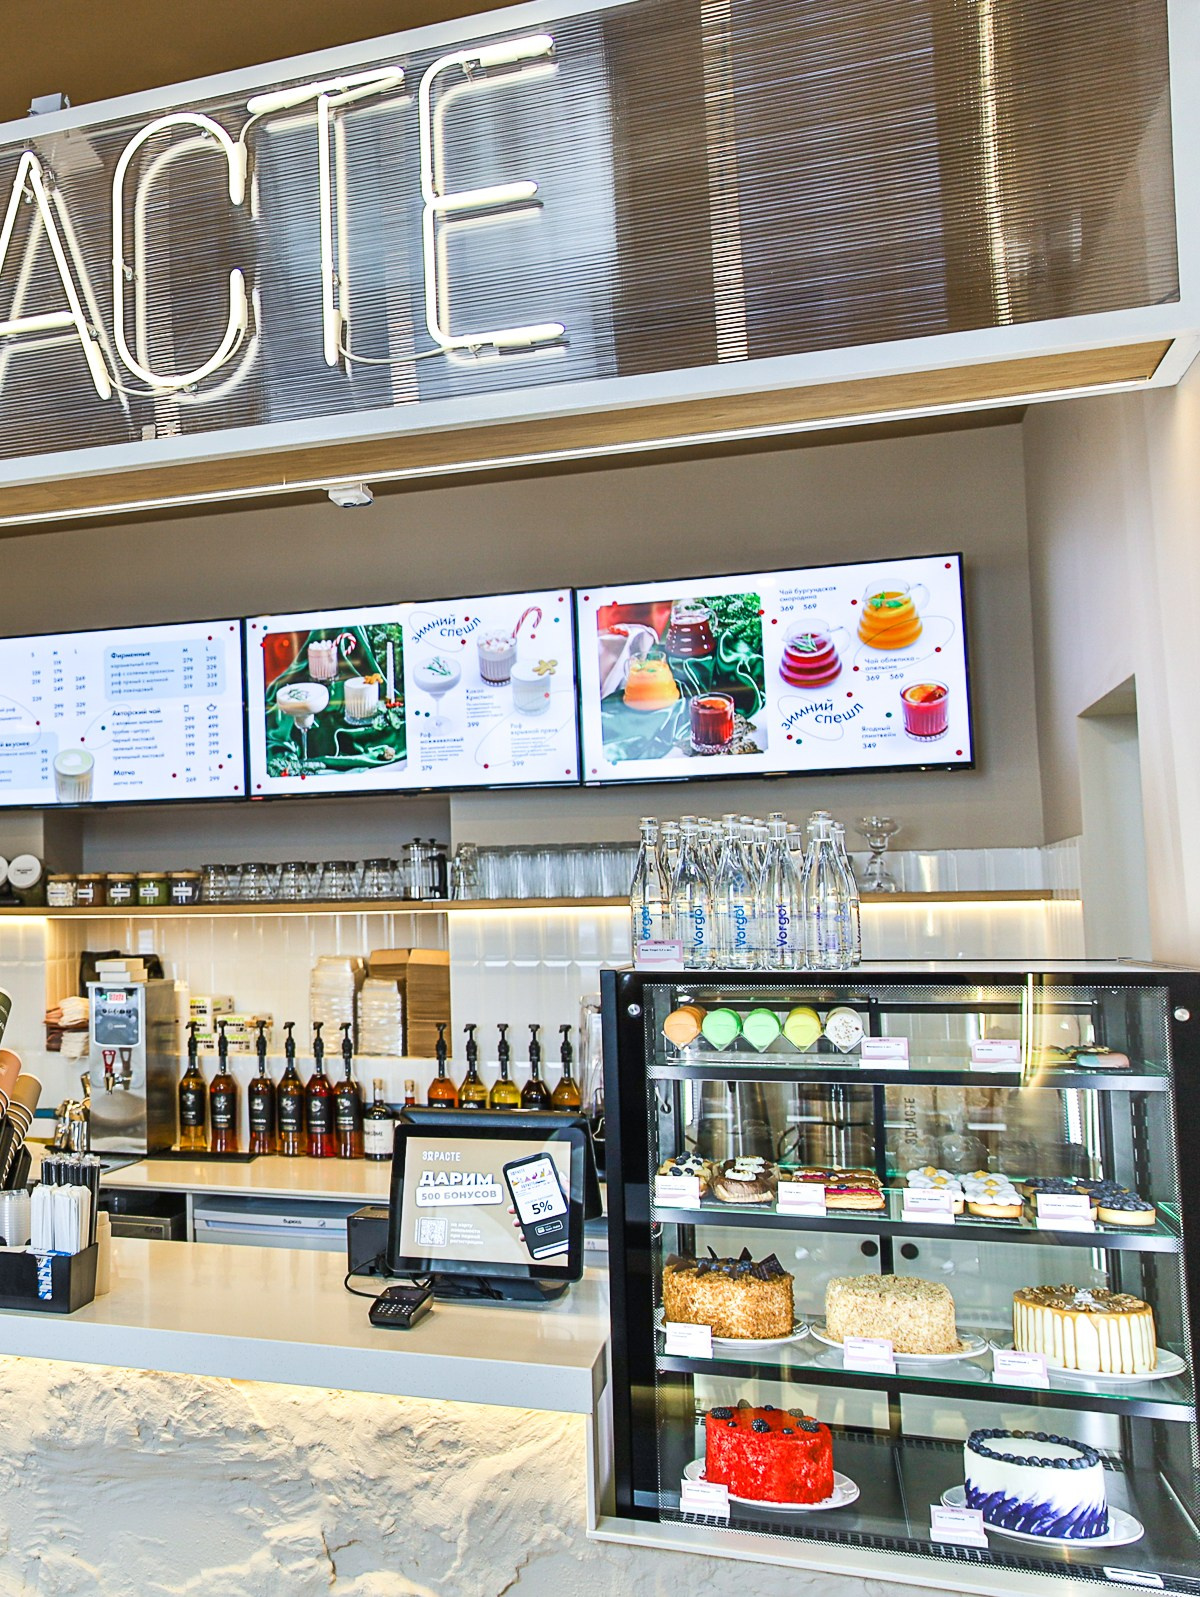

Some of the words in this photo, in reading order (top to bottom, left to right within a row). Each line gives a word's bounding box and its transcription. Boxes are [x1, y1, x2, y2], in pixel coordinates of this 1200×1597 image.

[412, 614, 456, 644] зимний
[440, 617, 481, 637] спешл
[111, 652, 150, 660] Фирменные
[781, 699, 834, 730] зимний
[814, 703, 864, 724] спешл
[641, 905, 652, 941] orgol
[694, 905, 705, 947] Vorgol
[734, 905, 748, 947] Vorgol
[776, 905, 790, 947] Vorgol
[422, 1151, 461, 1162] ЗДРАСТЕ
[419, 1170, 493, 1186] ДАРИМ
[421, 1192, 441, 1200] 500
[444, 1190, 497, 1199] БОНУСОВ
[532, 1200, 553, 1215] 5%
